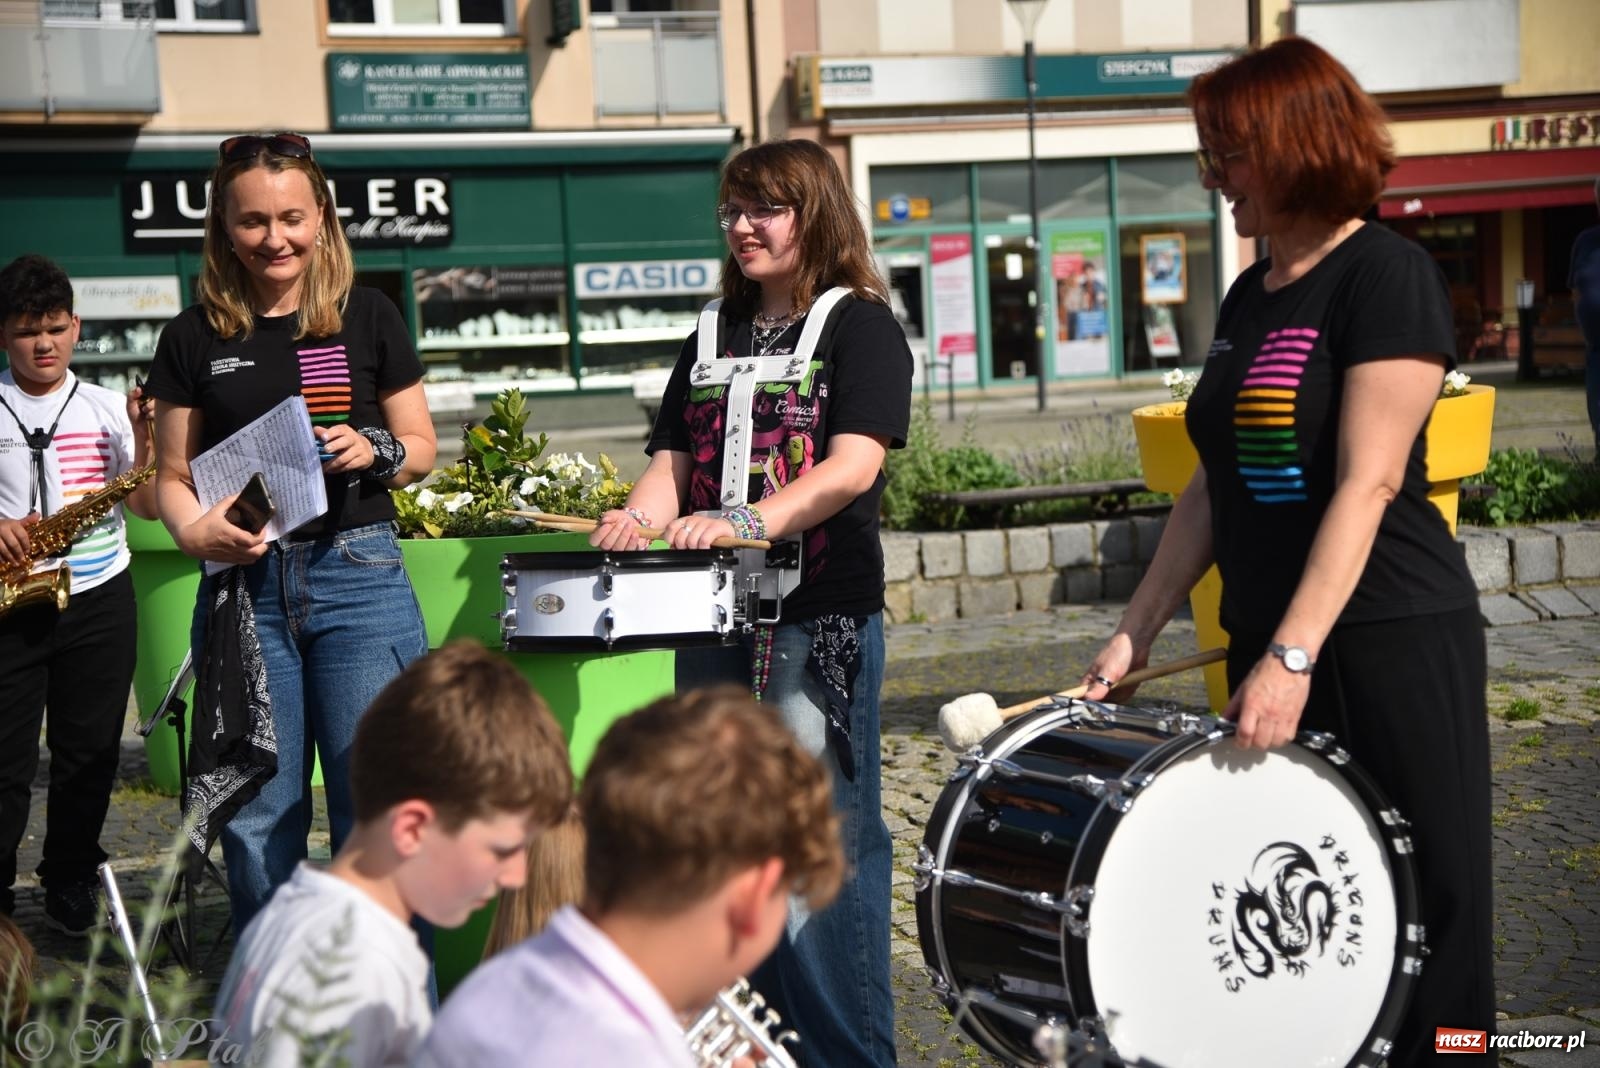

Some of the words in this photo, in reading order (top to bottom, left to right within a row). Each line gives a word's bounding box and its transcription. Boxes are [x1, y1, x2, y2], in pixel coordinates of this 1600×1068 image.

[131, 178, 450, 220] JULER
[585, 265, 707, 291] CASIO
[775, 399, 817, 415] Comics
[819, 388, 828, 397] 10
[1318, 833, 1364, 968] DRAGON'S
[1206, 880, 1246, 993] DRUMS
